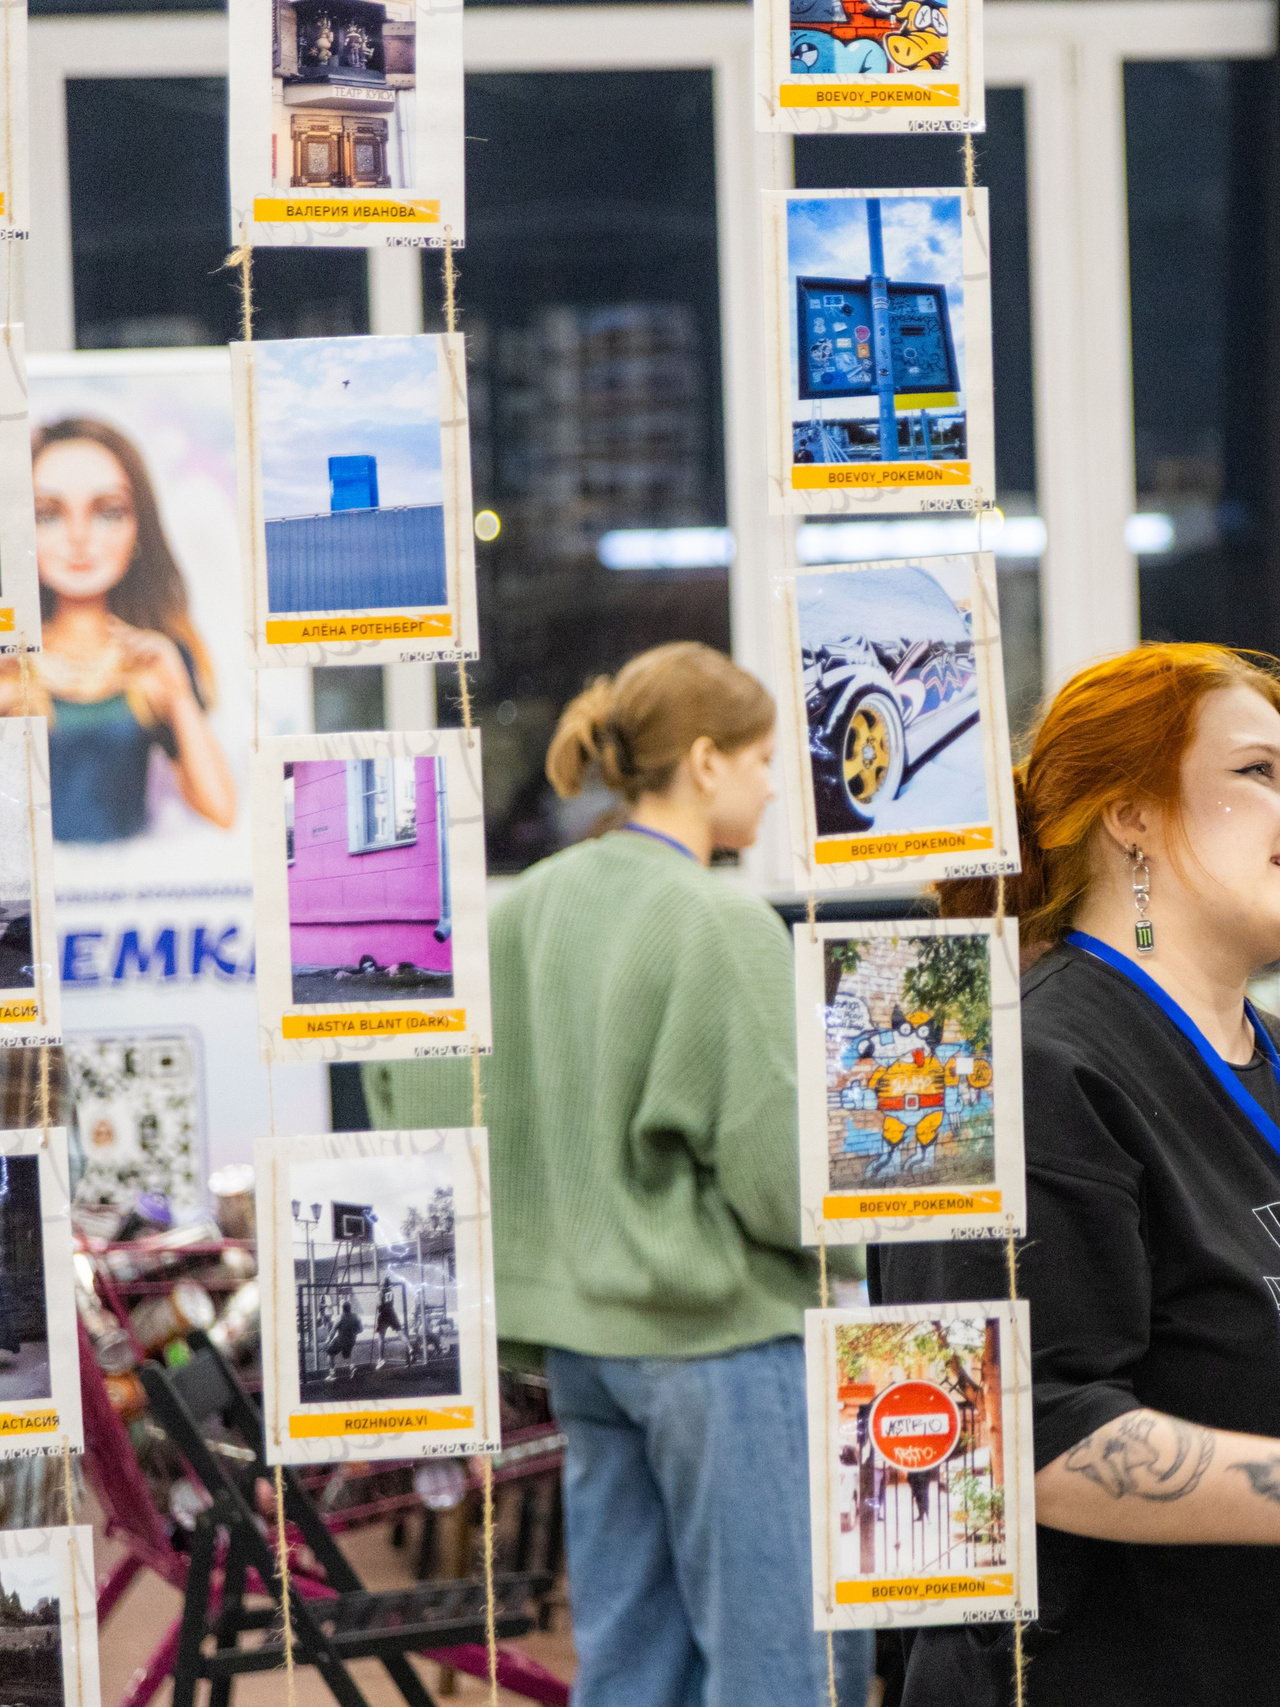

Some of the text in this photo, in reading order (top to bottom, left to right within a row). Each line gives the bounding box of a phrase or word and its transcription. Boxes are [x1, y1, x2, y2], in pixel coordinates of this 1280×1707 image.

[334, 86, 395, 100] ТЕАТР КУКОЛ
[816, 91, 931, 103] BOEVOY_POKEMON
[908, 120, 984, 132] ИСКРА ФЕС
[286, 205, 416, 218] ВАЛЕРИЯ ИВАНОВА
[386, 237, 430, 247] ИСКРА
[828, 470, 943, 483] BOEVOY_POKEMON
[920, 500, 958, 510] ИСКРА
[302, 621, 425, 637] АЛЁНА РОТЕНБЕРГ
[400, 651, 441, 662] ИСКРА
[851, 836, 966, 856] BOEVOY_POKEMON
[944, 864, 983, 878] ИСКРА
[60, 925, 255, 982] ЕМК
[307, 1016, 450, 1032] NASTYA BLANT (DARK)
[414, 1046, 452, 1057] ИСКРА
[859, 1198, 974, 1213] BOEVOY_POKEMON
[951, 1227, 989, 1239] ИСКРА
[0, 1416, 60, 1430] АСТАСИЯ
[345, 1415, 428, 1430] ROZHNOVA.VI
[5, 1447, 45, 1459] ИСКРА
[422, 1443, 460, 1456] ИСКРА
[872, 1581, 985, 1597] BOEVOY_POKEMON
[962, 1610, 1001, 1622] ИСКРА
